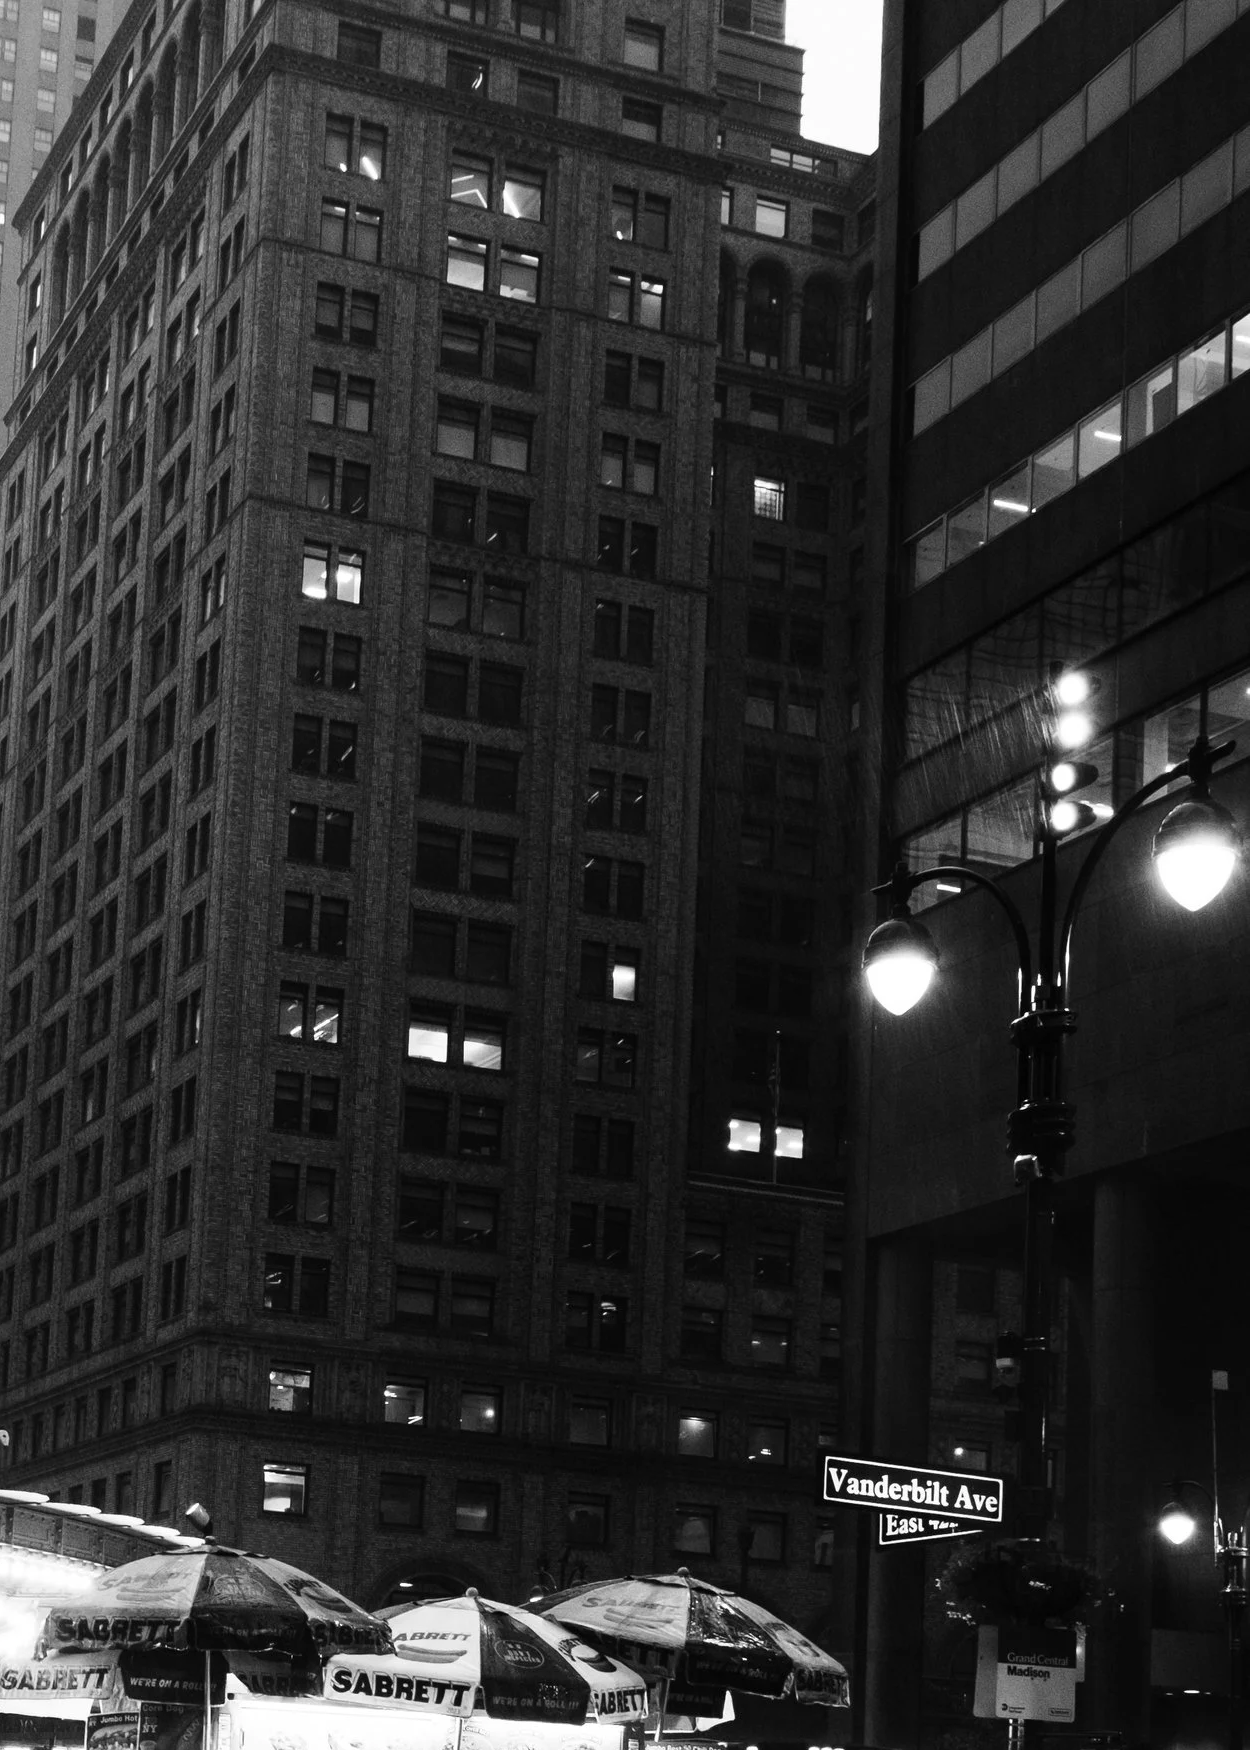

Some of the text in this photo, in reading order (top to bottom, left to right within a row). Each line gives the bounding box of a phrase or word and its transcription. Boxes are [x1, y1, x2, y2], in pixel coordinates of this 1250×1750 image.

[829, 1468, 998, 1513] Vanderbilt Ave
[886, 1514, 925, 1537] East
[393, 1632, 471, 1642] ABRETT
[1007, 1652, 1069, 1666] Grand Central
[0, 1665, 111, 1691] SABRETT
[1007, 1665, 1050, 1679] Madison
[130, 1677, 156, 1687] WE'RE
[159, 1680, 172, 1688] ON
[173, 1680, 180, 1689] A
[332, 1667, 471, 1707] SABRETT
[493, 1696, 517, 1706] WE'RE
[521, 1697, 533, 1706] ON
[536, 1698, 542, 1707] A
[142, 1704, 184, 1715] Corn Dog
[100, 1716, 122, 1724] Jumbo
[142, 1725, 158, 1733] NY
